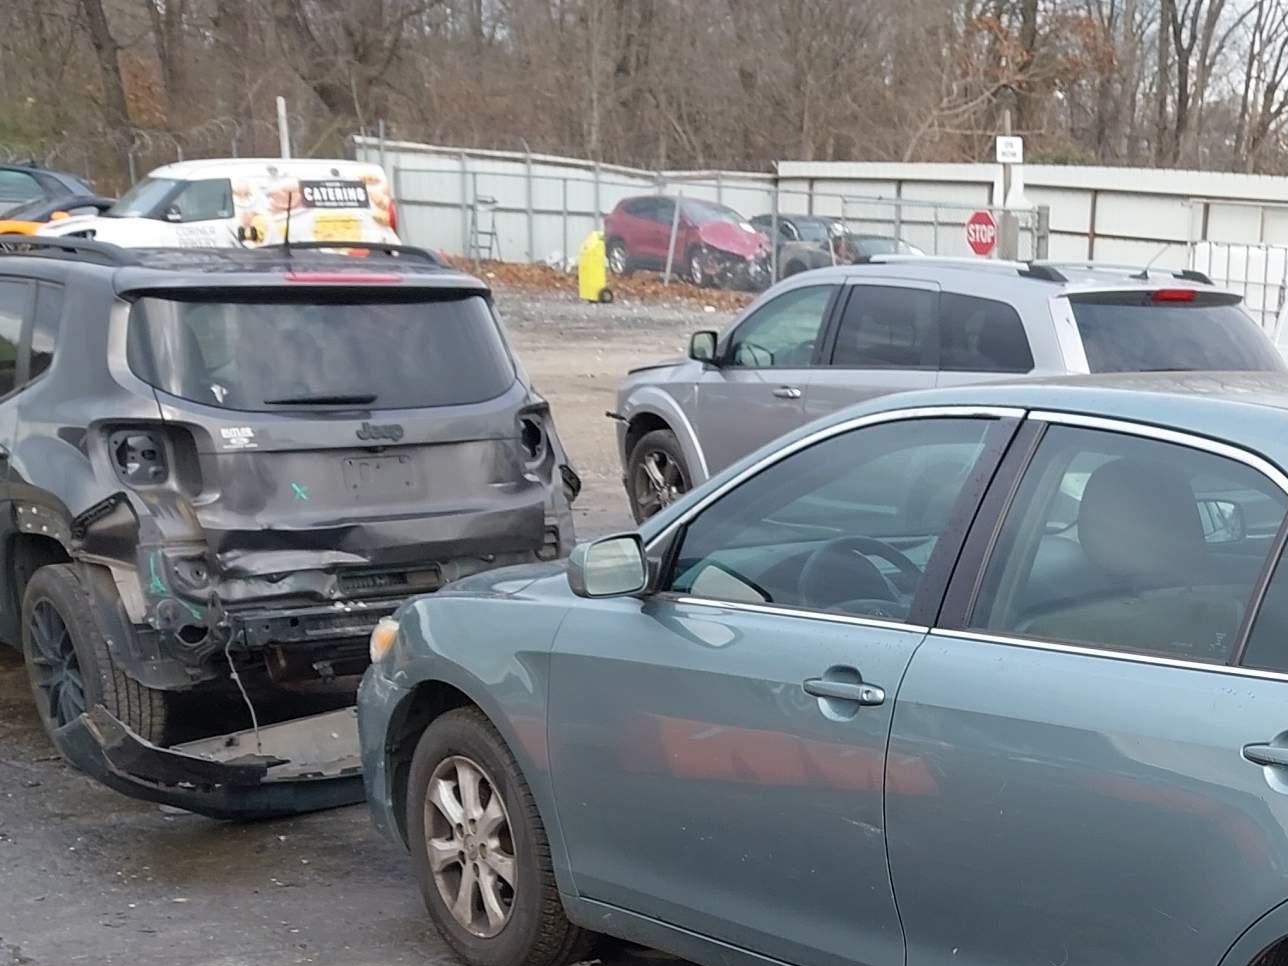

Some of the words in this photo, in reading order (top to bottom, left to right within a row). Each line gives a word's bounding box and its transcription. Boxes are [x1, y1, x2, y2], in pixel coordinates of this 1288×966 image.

[303, 187, 366, 201] CATERING
[968, 223, 994, 243] STOP
[356, 421, 405, 441] Jeep
